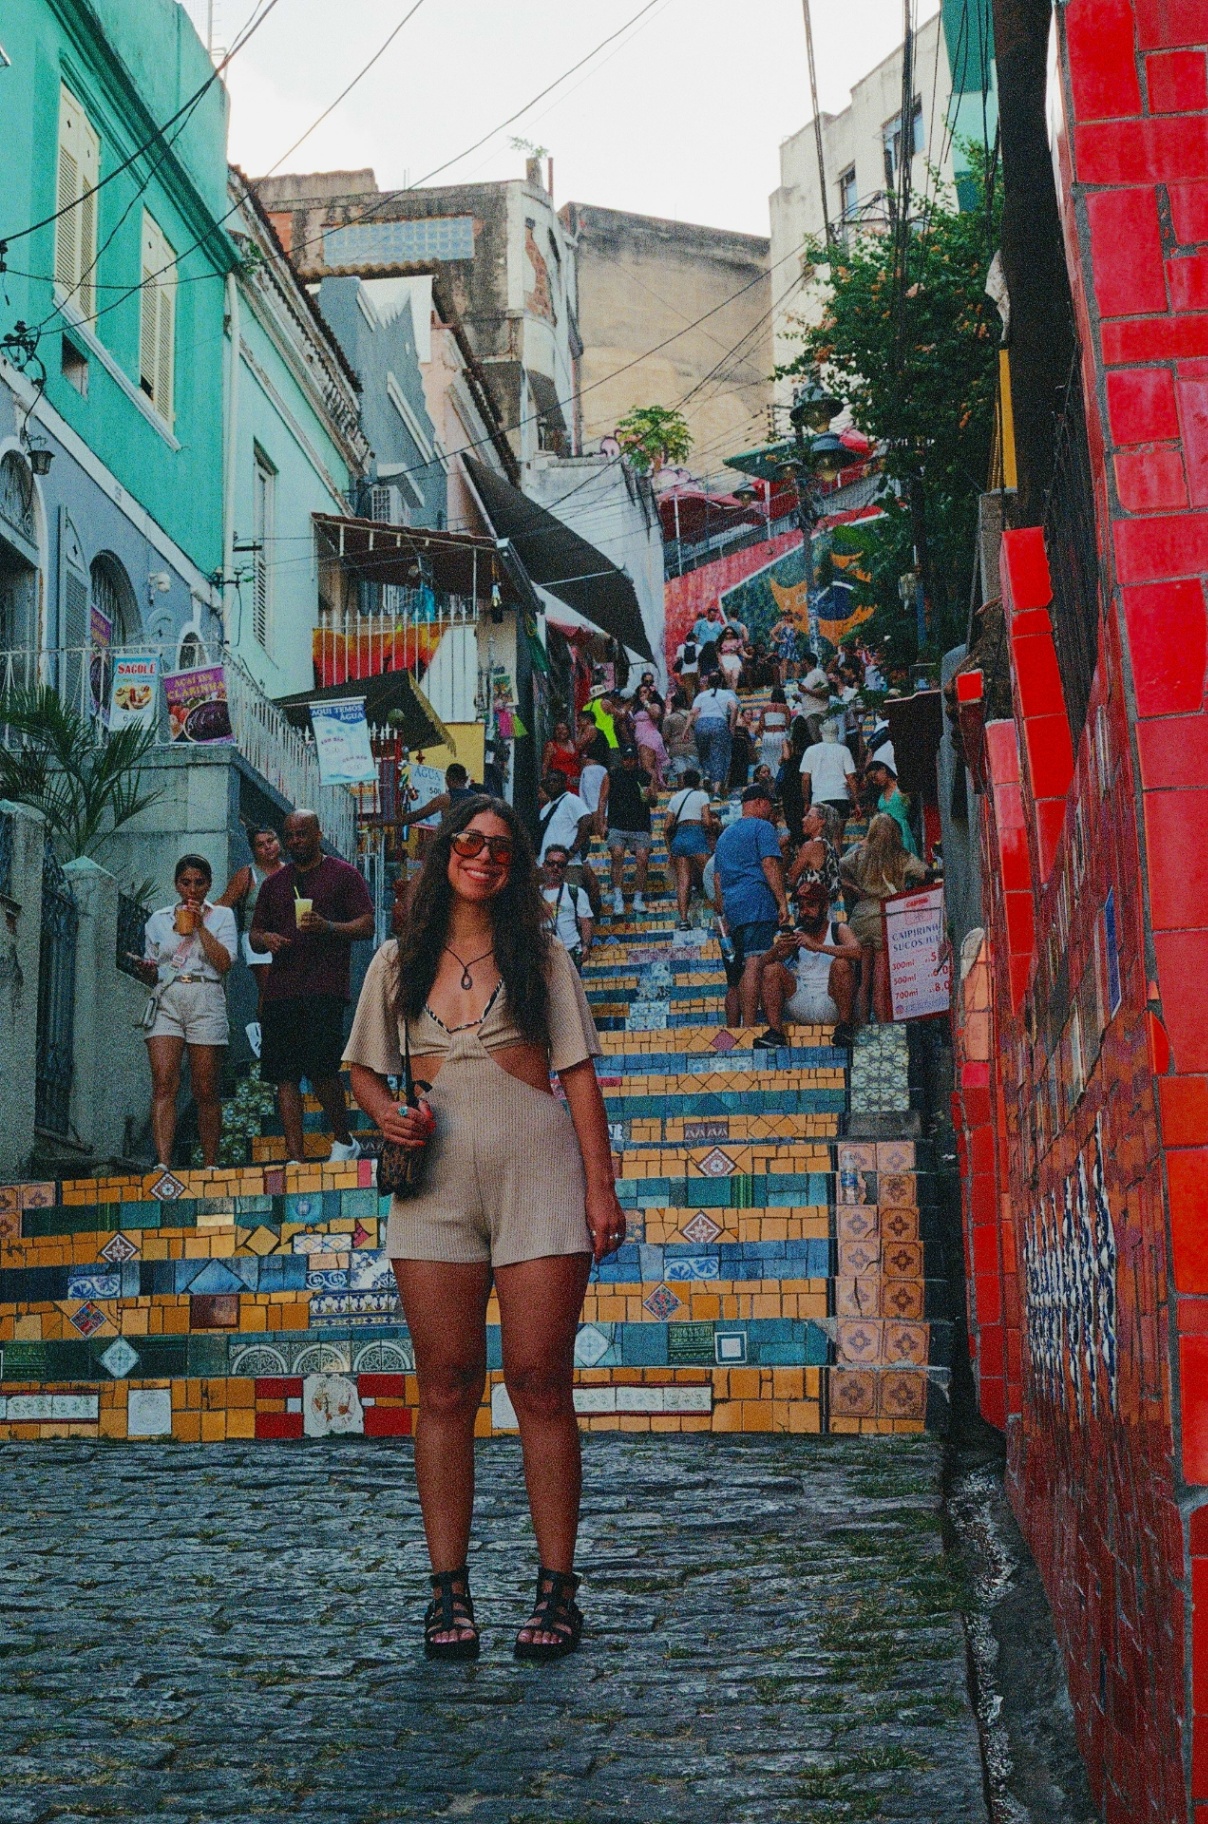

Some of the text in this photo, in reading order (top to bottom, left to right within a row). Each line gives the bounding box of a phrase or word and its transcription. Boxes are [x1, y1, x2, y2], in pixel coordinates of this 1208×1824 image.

[167, 681, 225, 700] CLARINHA
[311, 704, 363, 717] AQUI TEMOS
[892, 923, 939, 942] CAIPIRINH
[893, 938, 924, 952] SUCOS
